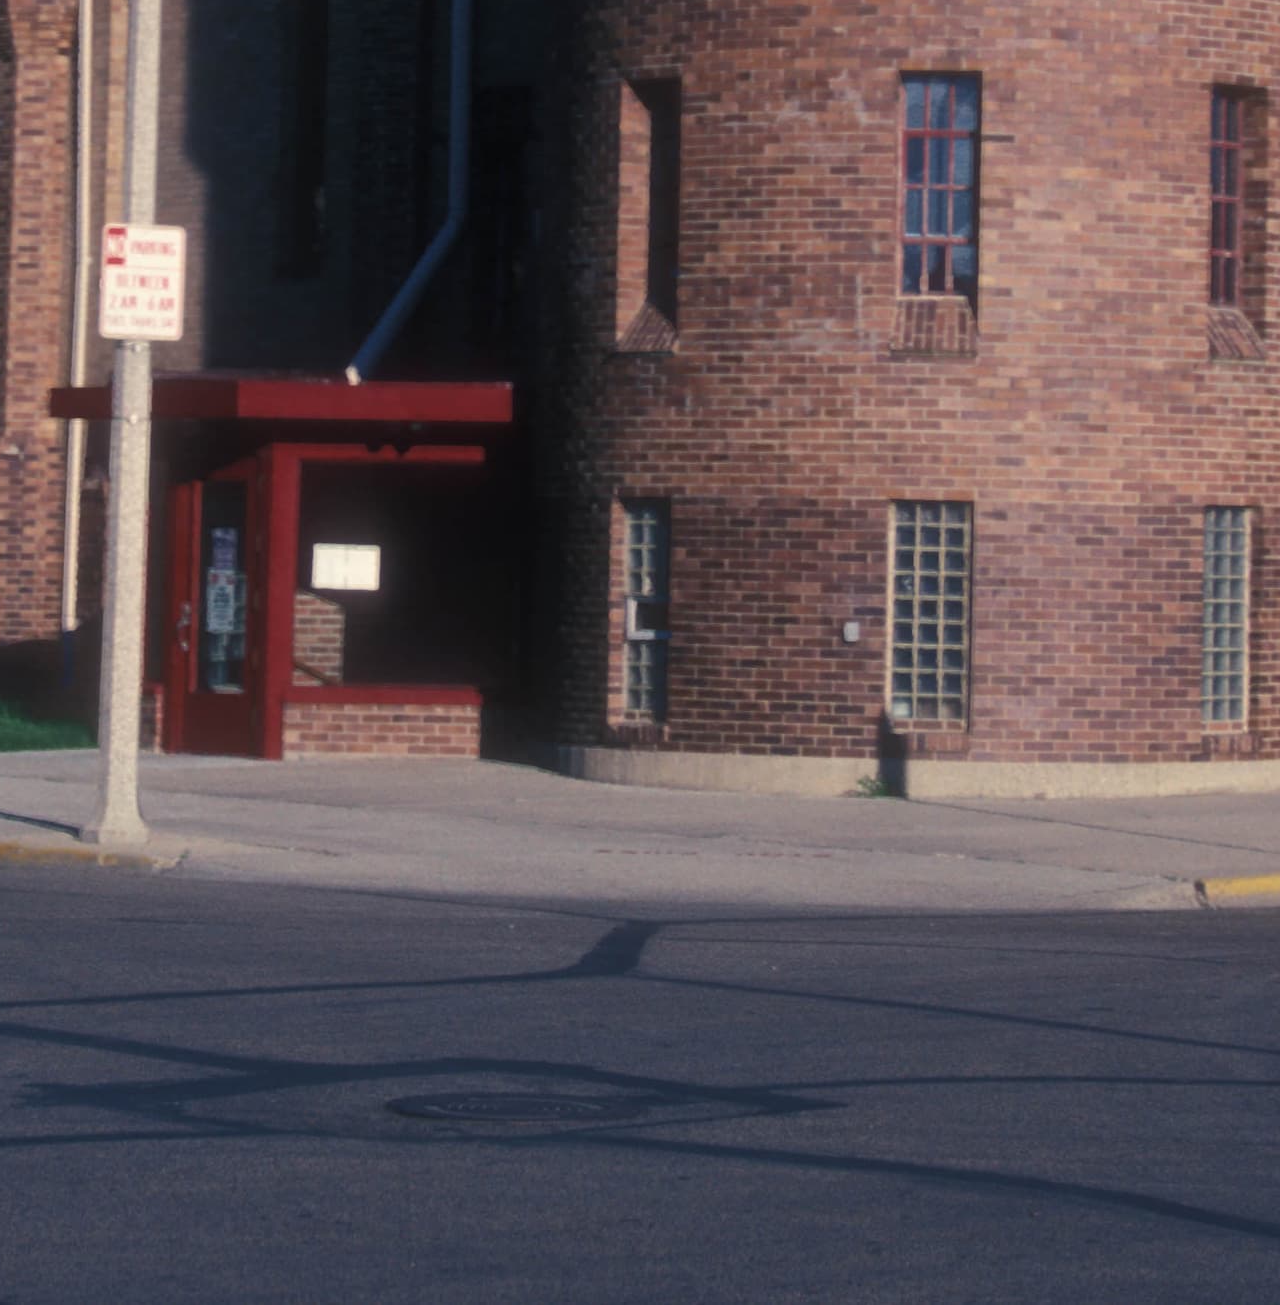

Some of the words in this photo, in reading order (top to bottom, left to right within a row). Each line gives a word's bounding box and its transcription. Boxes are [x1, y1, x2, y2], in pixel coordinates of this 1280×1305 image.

[130, 241, 176, 255] PARKING
[120, 295, 137, 309] AM
[158, 297, 175, 311] AM
